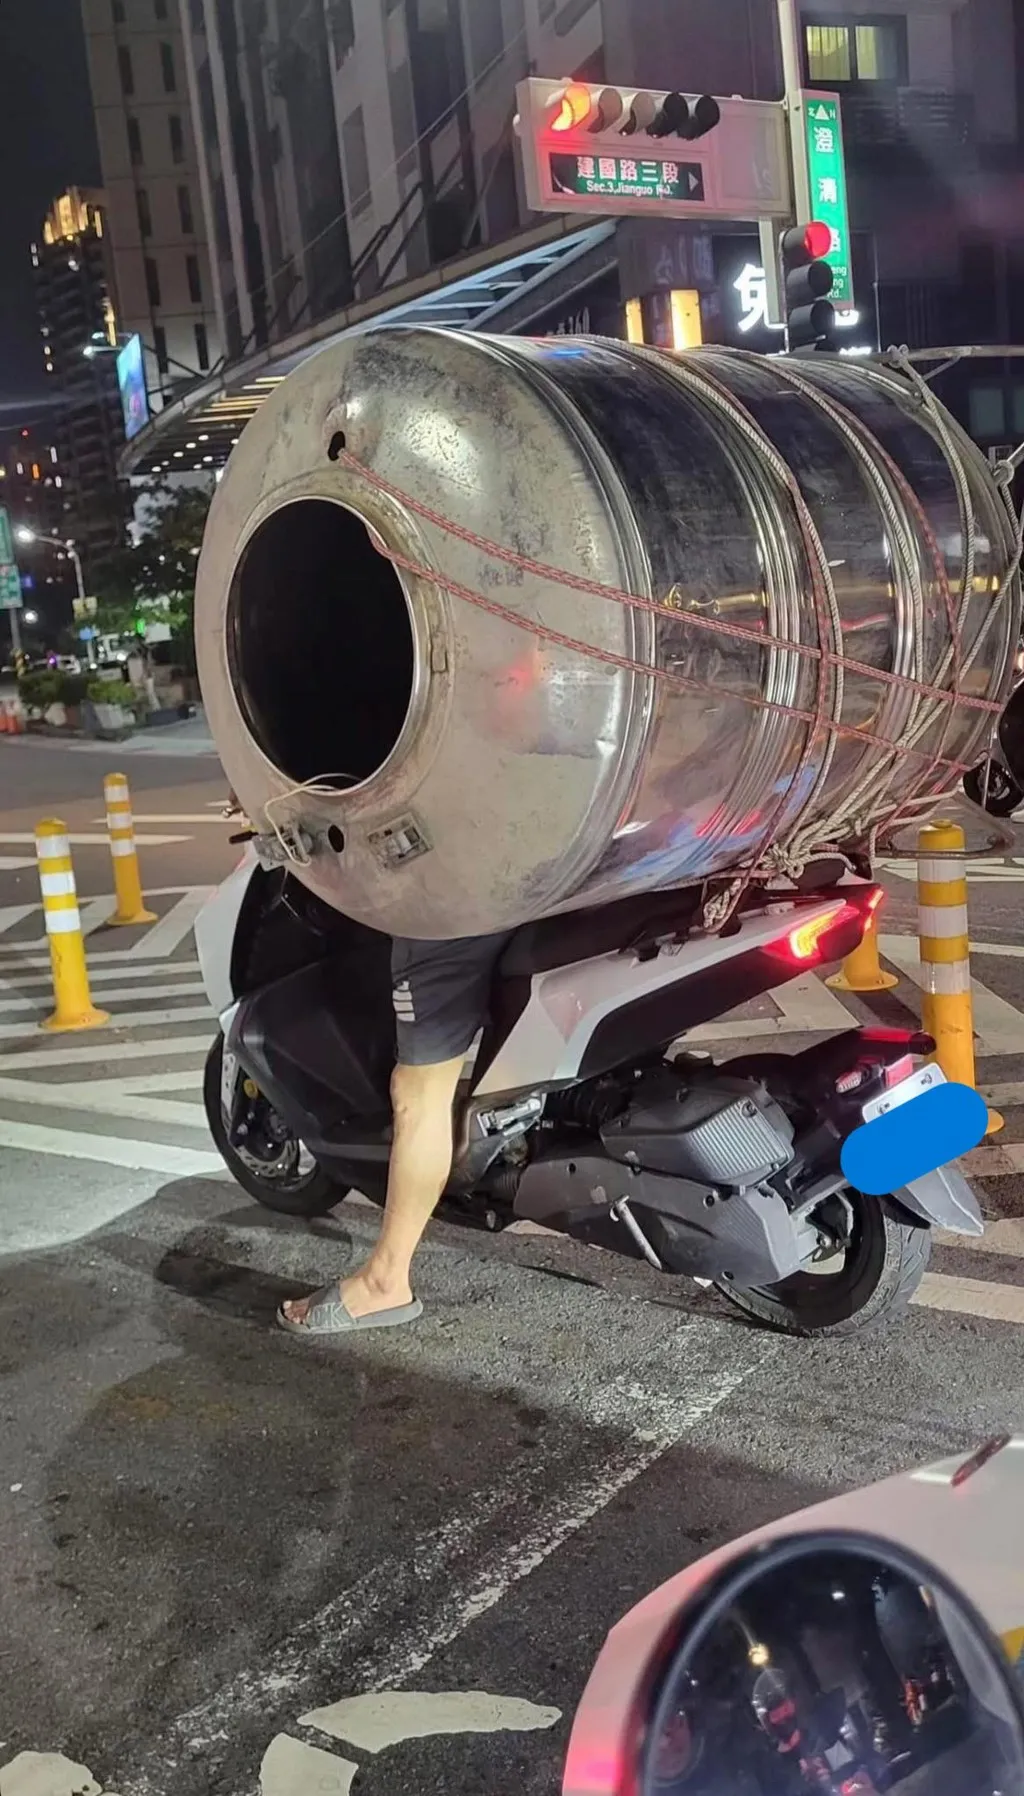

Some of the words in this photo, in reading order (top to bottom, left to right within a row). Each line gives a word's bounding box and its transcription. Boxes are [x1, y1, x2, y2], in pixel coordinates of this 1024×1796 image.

[576, 156, 680, 184] 建國路三段
